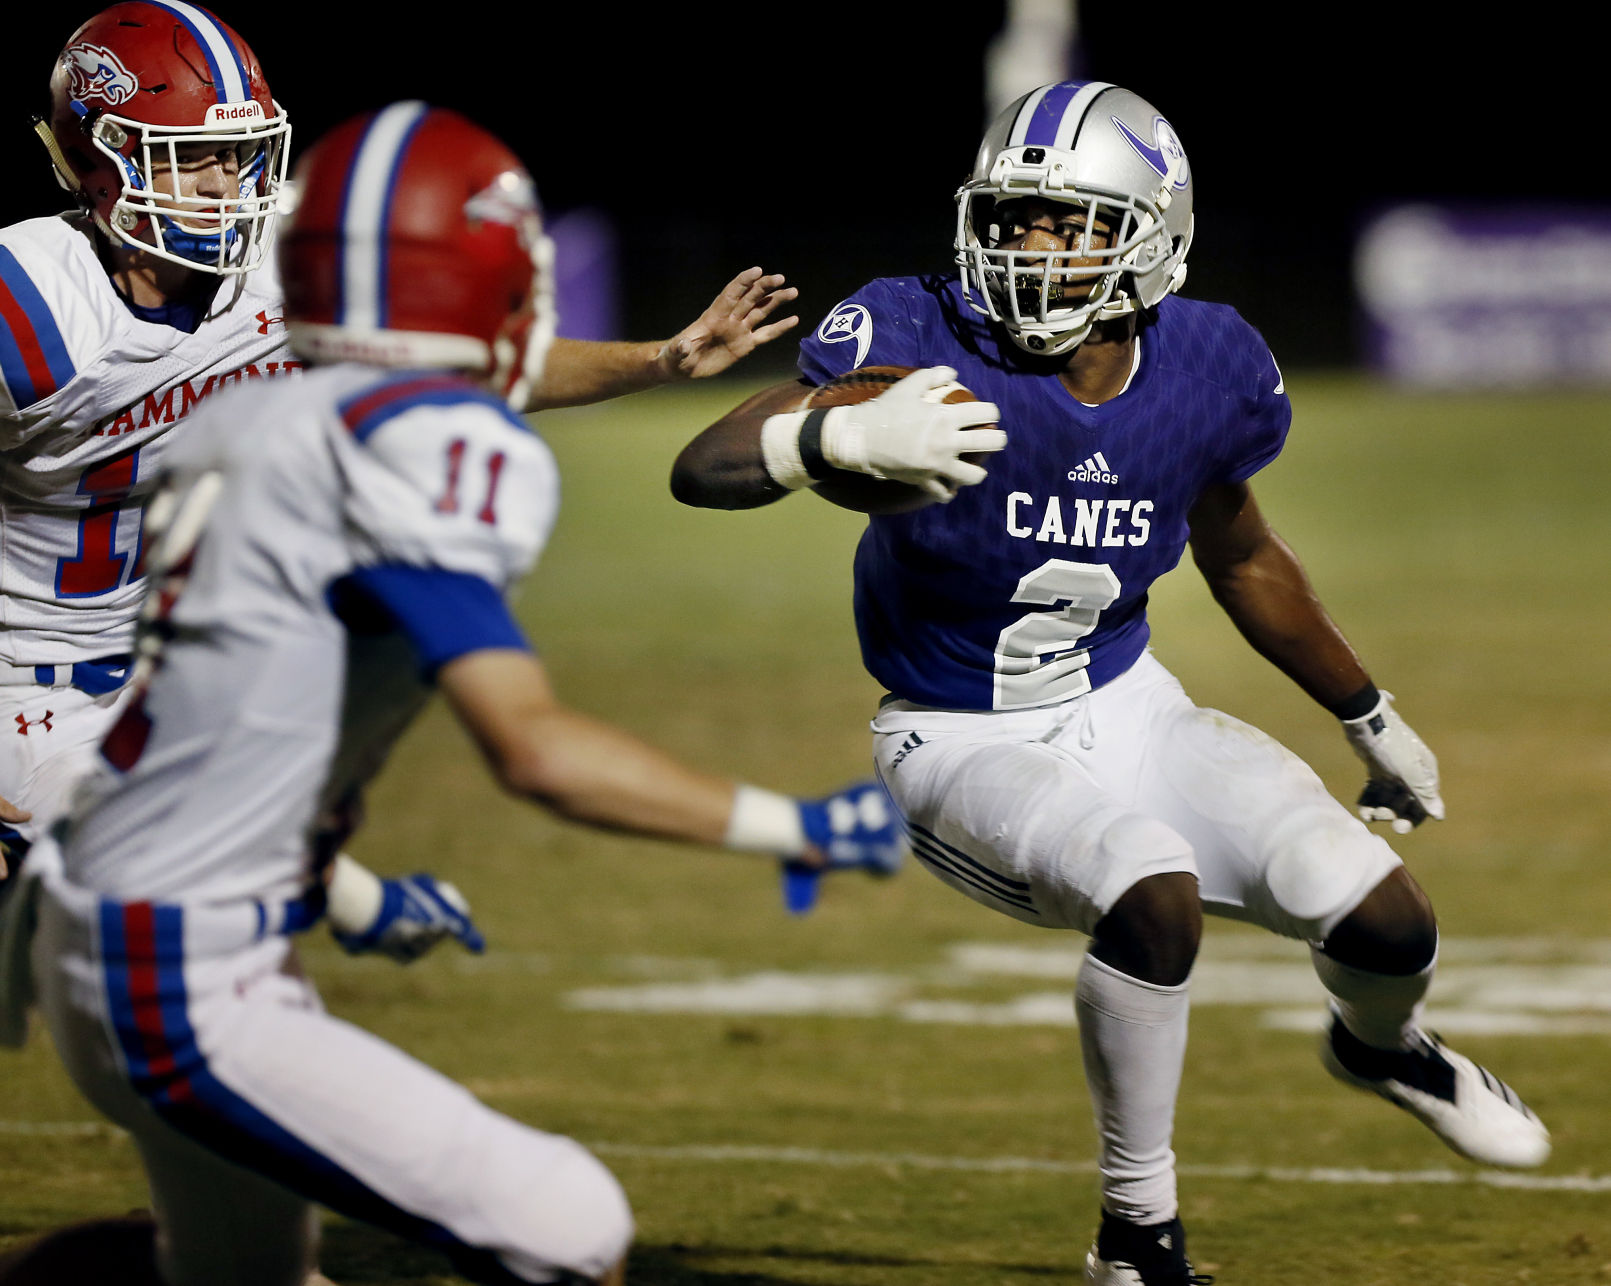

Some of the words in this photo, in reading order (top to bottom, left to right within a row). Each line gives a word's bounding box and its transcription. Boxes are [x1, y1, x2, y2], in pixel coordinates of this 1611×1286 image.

[216, 104, 260, 120] Riddell
[434, 437, 505, 525] 11
[1067, 469, 1119, 485] adidas
[1006, 491, 1154, 547] CANES
[993, 558, 1122, 710] 2
